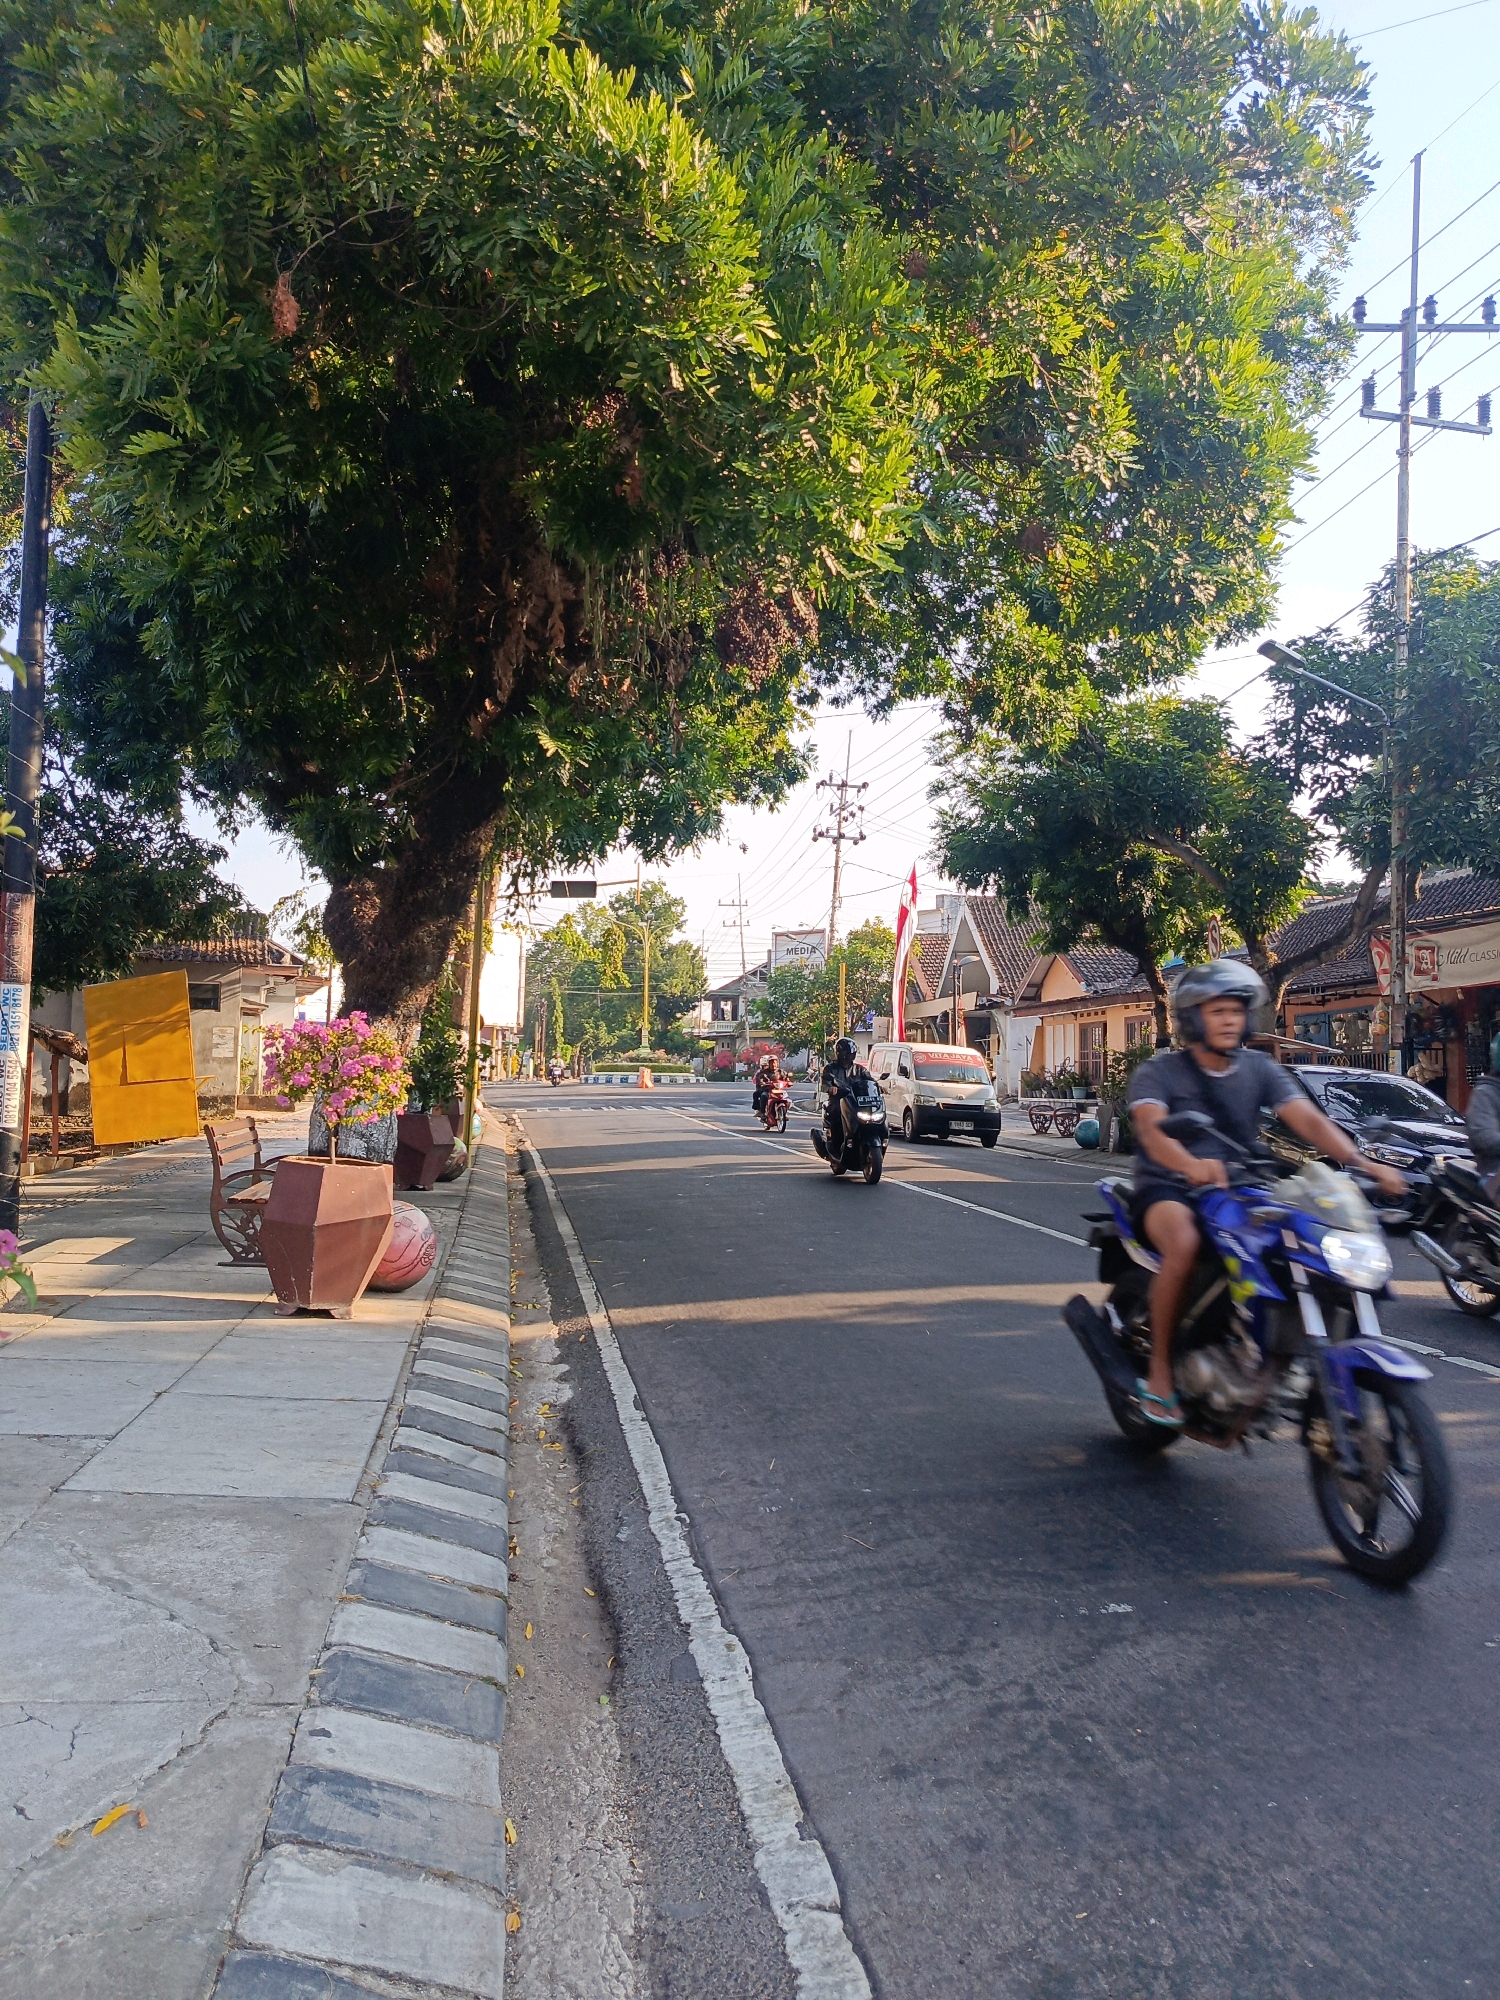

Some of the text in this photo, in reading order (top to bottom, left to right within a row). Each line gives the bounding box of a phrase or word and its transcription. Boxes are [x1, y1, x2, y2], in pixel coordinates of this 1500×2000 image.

[786, 946, 816, 955] MEDIA
[1438, 948, 1469, 966] Mild
[1469, 949, 1500, 963] CLASSI
[0, 988, 10, 1051] SEDOT WC
[9, 987, 22, 1052] 0821 3151 8178
[950, 1053, 973, 1061] JAYA
[5, 1082, 18, 1102] 1104
[4, 1104, 16, 1124] 0812
